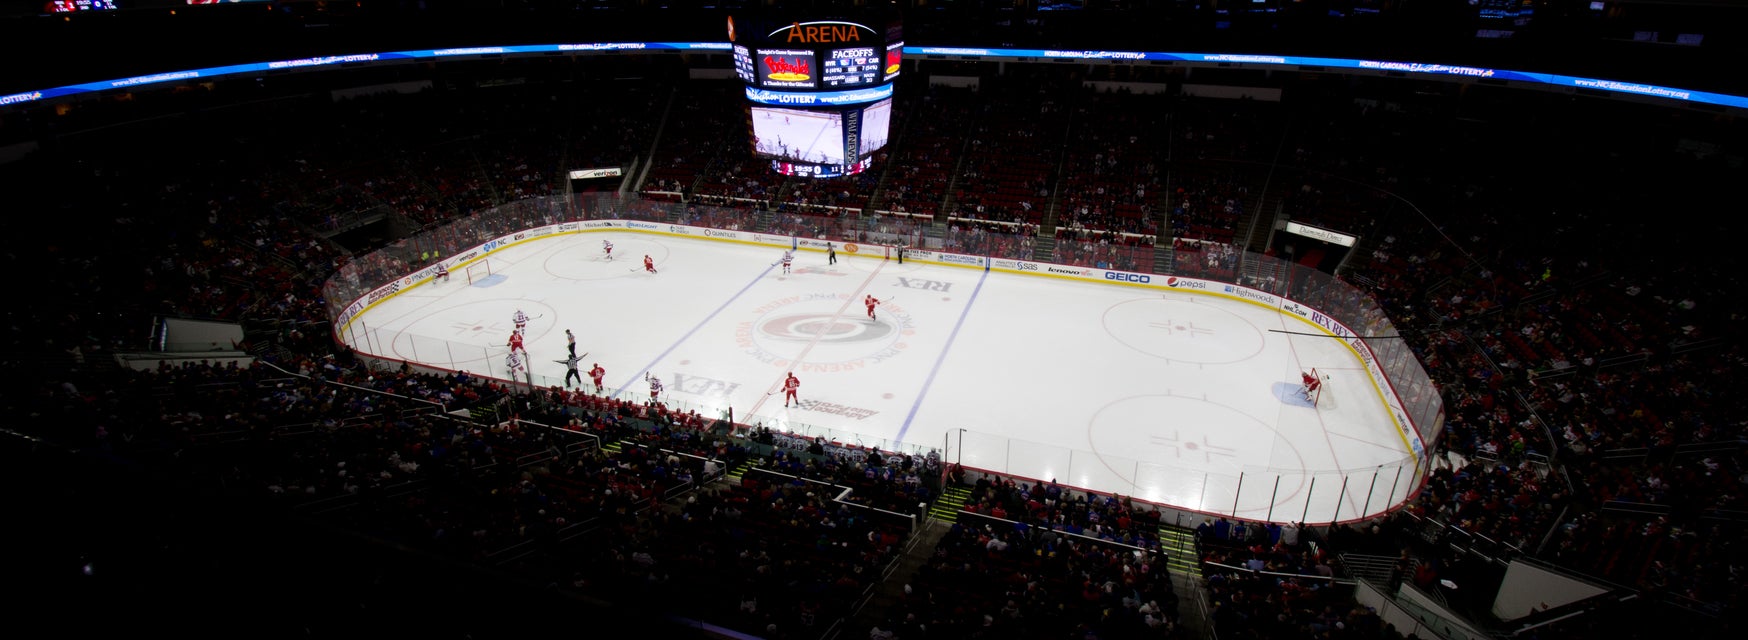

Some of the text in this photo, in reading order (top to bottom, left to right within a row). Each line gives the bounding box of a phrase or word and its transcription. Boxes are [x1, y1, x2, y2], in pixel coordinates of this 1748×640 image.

[787, 22, 860, 43] ARENA
[832, 49, 873, 58] FACEOFFS
[1359, 60, 1482, 76] NORTH CAROLINA Education LOTTERY
[1574, 78, 1690, 99] www.NC-EducationLottery.org
[779, 94, 817, 103] LOTTERY
[787, 165, 793, 173] 1
[814, 165, 821, 174] 0
[1023, 262, 1038, 271] sas
[1048, 266, 1080, 275] lenovo
[1105, 271, 1150, 284] GEICO
[1180, 280, 1206, 289] pepsi
[1231, 285, 1275, 304] Highwoods
[1283, 304, 1307, 317] NHL.COM
[1311, 311, 1350, 341] REX REX
